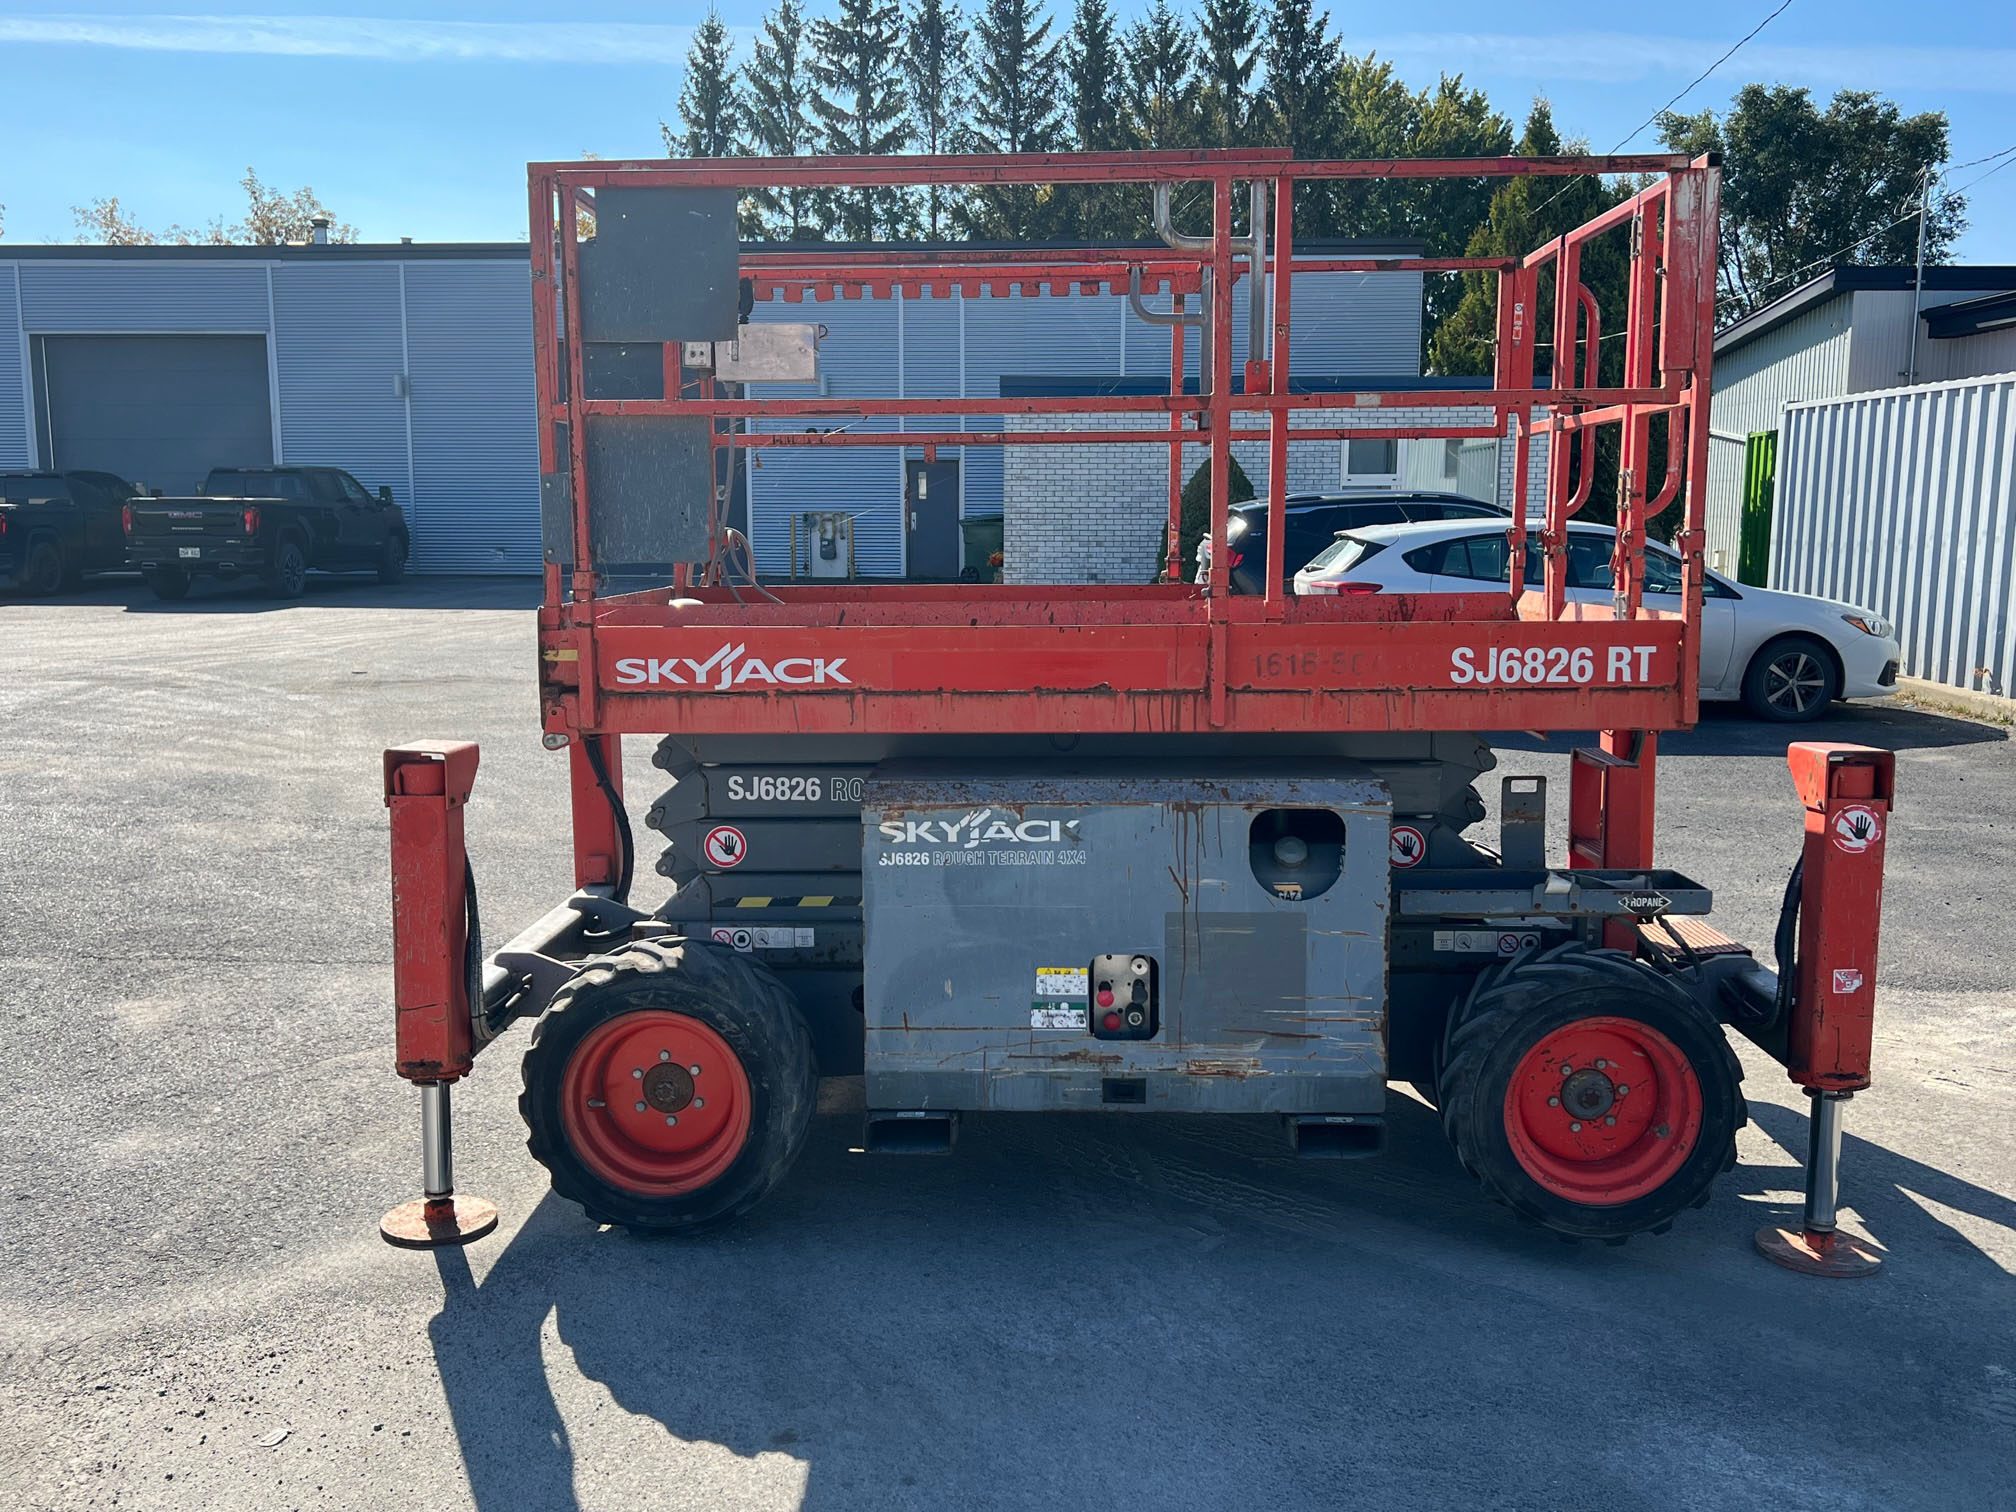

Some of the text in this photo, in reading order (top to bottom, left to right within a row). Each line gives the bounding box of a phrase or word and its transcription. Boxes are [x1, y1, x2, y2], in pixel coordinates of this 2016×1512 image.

[615, 642, 852, 690] SKYJACK
[1450, 645, 1657, 684] SJ6826 RT
[728, 775, 822, 801] SJ6826
[878, 849, 1087, 866] SJ6826 ROUGH TERRAIN 4X4
